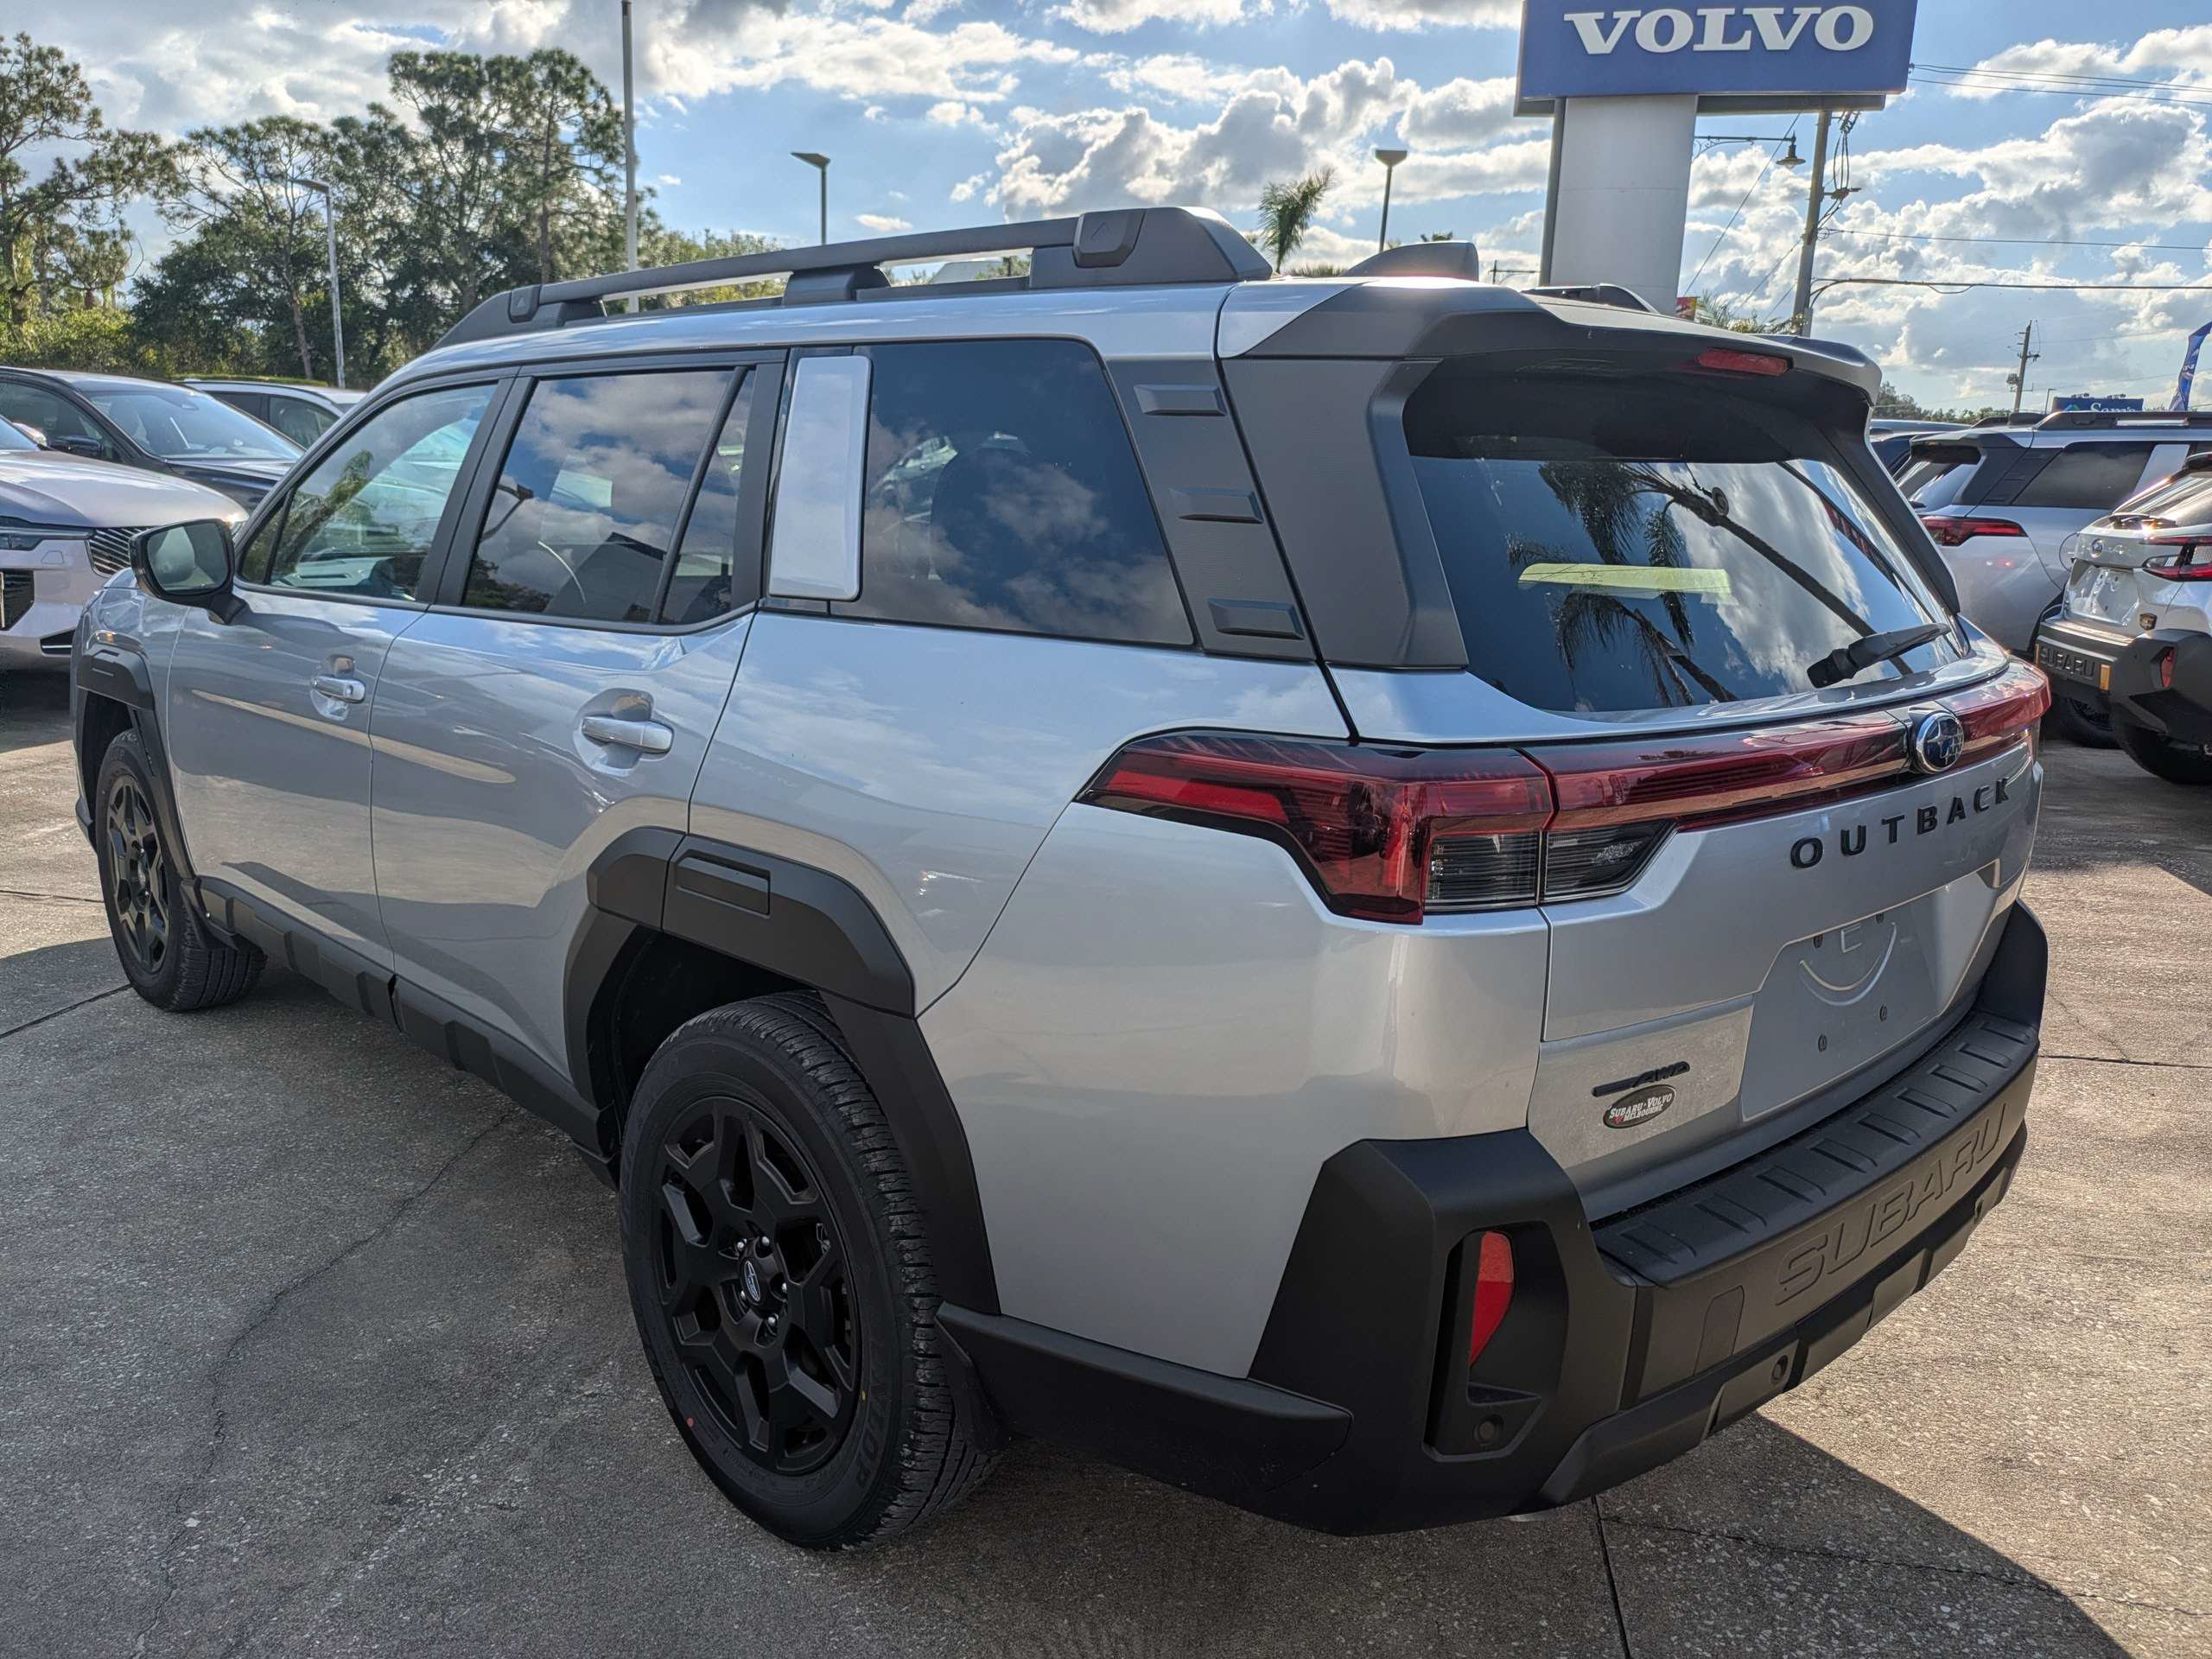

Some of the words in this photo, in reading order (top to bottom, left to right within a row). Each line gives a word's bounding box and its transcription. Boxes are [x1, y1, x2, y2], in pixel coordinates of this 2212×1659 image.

[1563, 5, 1874, 54] VOLVO
[2039, 645, 2096, 681] SUBARU
[1790, 777, 2010, 868] OUTBACK
[1632, 1061, 1691, 1088] AWD
[1609, 1103, 1643, 1119] SUBARU
[1647, 1093, 1673, 1108] VOLVO
[1623, 1104, 1664, 1122] MELBOURNE
[1776, 1103, 2006, 1306] SUBARU
